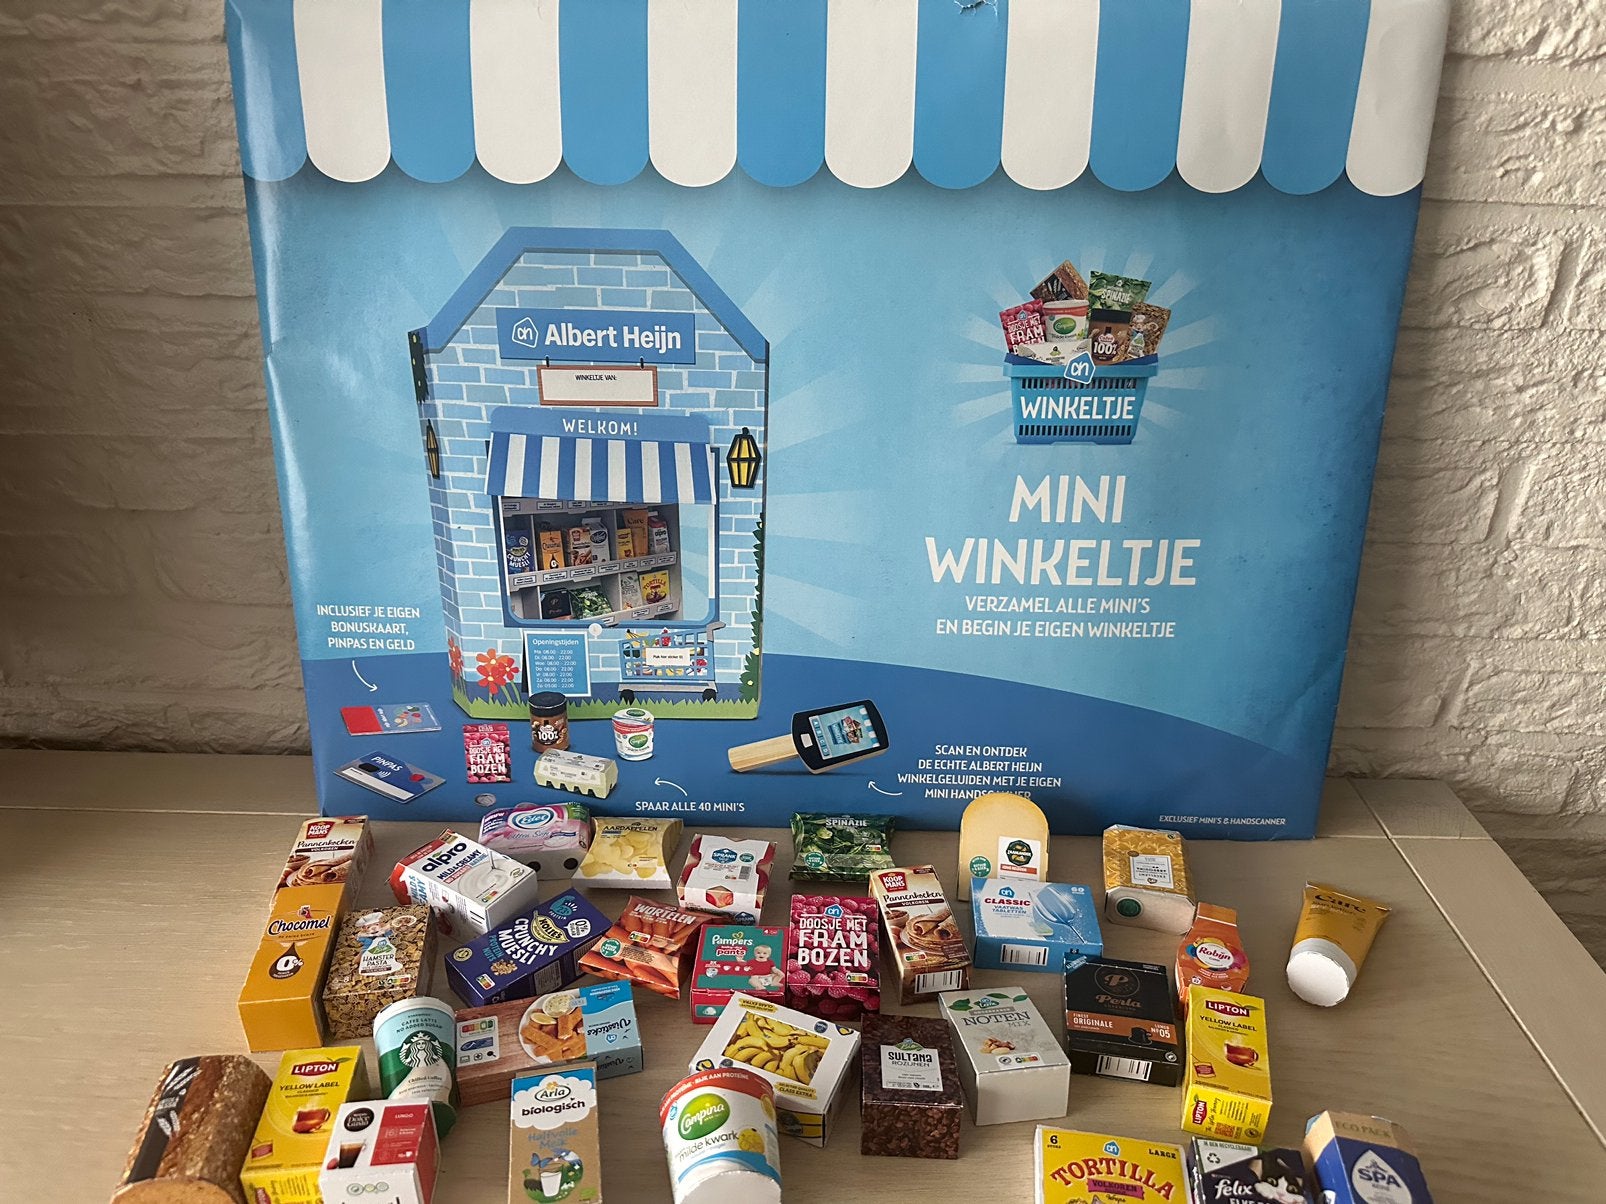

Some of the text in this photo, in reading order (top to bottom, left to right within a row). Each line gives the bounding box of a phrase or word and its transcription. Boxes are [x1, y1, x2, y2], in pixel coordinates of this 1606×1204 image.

[1101, 286, 1132, 304] SPINAZIE
[544, 323, 681, 354] Albert Heijn
[1010, 324, 1045, 345] FRAM
[1093, 342, 1118, 355] 100%
[574, 374, 604, 382] WINKELTJE
[1020, 396, 1136, 420] WINKELTJE
[562, 418, 639, 436] WELKOM!
[1008, 474, 1126, 523] MINI
[925, 536, 1201, 586] WINKELTJE
[965, 595, 1151, 614] VERZAMEL ALLE MINI'S
[317, 605, 420, 618] INCLUSIEF JE EIGEN
[331, 622, 409, 636] BONUSKAART,
[936, 619, 1176, 638] EN BEGIN JE EIGEN WINKELTJE
[327, 638, 415, 650] PINPAS EN GELD
[532, 638, 579, 647] Openingstijden
[935, 744, 1027, 757] SCAN EN ONTDEK
[371, 756, 404, 772] PINPAS
[469, 753, 506, 765] FRAM
[918, 759, 1042, 772] DE ECHTE ALBERT HEIJN
[471, 763, 507, 775] BOZEN
[897, 773, 1061, 788] WINKELGELUIDEN MET JE EIGEN
[925, 788, 948, 798] MINI
[635, 801, 745, 812] SPAAR ALLE 40 MINI'S
[826, 819, 868, 827] SPINAZIE
[1159, 815, 1286, 826] EXCLUSIEF MINI'S & HANDSCANNER
[309, 824, 331, 832] KOOP
[297, 838, 356, 848] Pannenkoeken
[421, 842, 468, 872] alpro
[883, 875, 903, 884] KOOP
[885, 881, 906, 889] MANS
[883, 890, 943, 903] Pannenkoeken
[984, 897, 1031, 907] CLASSIC
[633, 903, 698, 925] WORTELEN
[268, 915, 331, 936] Chocomel
[576, 919, 590, 932] 0%
[799, 918, 868, 931] DOOSJE MET
[514, 917, 559, 957] CRUNCHY
[712, 934, 753, 946] Pampers
[799, 929, 868, 950] FRAM
[488, 935, 503, 959] PROTEIN
[498, 928, 537, 965] MUESLI
[715, 949, 747, 957] pants
[362, 953, 395, 962] HAMSTER
[797, 948, 868, 968] BOZEN
[1199, 946, 1231, 961] Robijn
[275, 955, 304, 972] 0%
[1095, 994, 1142, 1008] Perla
[1207, 1002, 1249, 1016] LIPTON
[961, 1011, 1031, 1026] NOTEN
[1073, 1017, 1114, 1029] ORIGINALE
[1199, 1015, 1232, 1028] YELLOW
[1231, 1020, 1257, 1032] LABEL
[405, 1023, 425, 1031] ADDED
[587, 1018, 631, 1036] Vissticks
[1159, 1029, 1171, 1039] 05
[293, 1063, 337, 1074] LIPTON
[279, 1082, 313, 1092] YELLOW
[540, 1088, 566, 1099] Arla
[779, 1087, 813, 1098] CLASS EXTRA
[522, 1099, 586, 1116] biologisch
[1193, 1101, 1206, 1126] LIPTON
[680, 1103, 725, 1136] Campina
[678, 1130, 740, 1163] milde kwark
[1049, 1135, 1058, 1145] 6
[1148, 1149, 1177, 1160] LARGE
[1049, 1157, 1176, 1201] TORTILLA
[1357, 1167, 1402, 1189] SPA
[1091, 1179, 1138, 1192] VOLKOREN
[1214, 1178, 1253, 1200] felix
